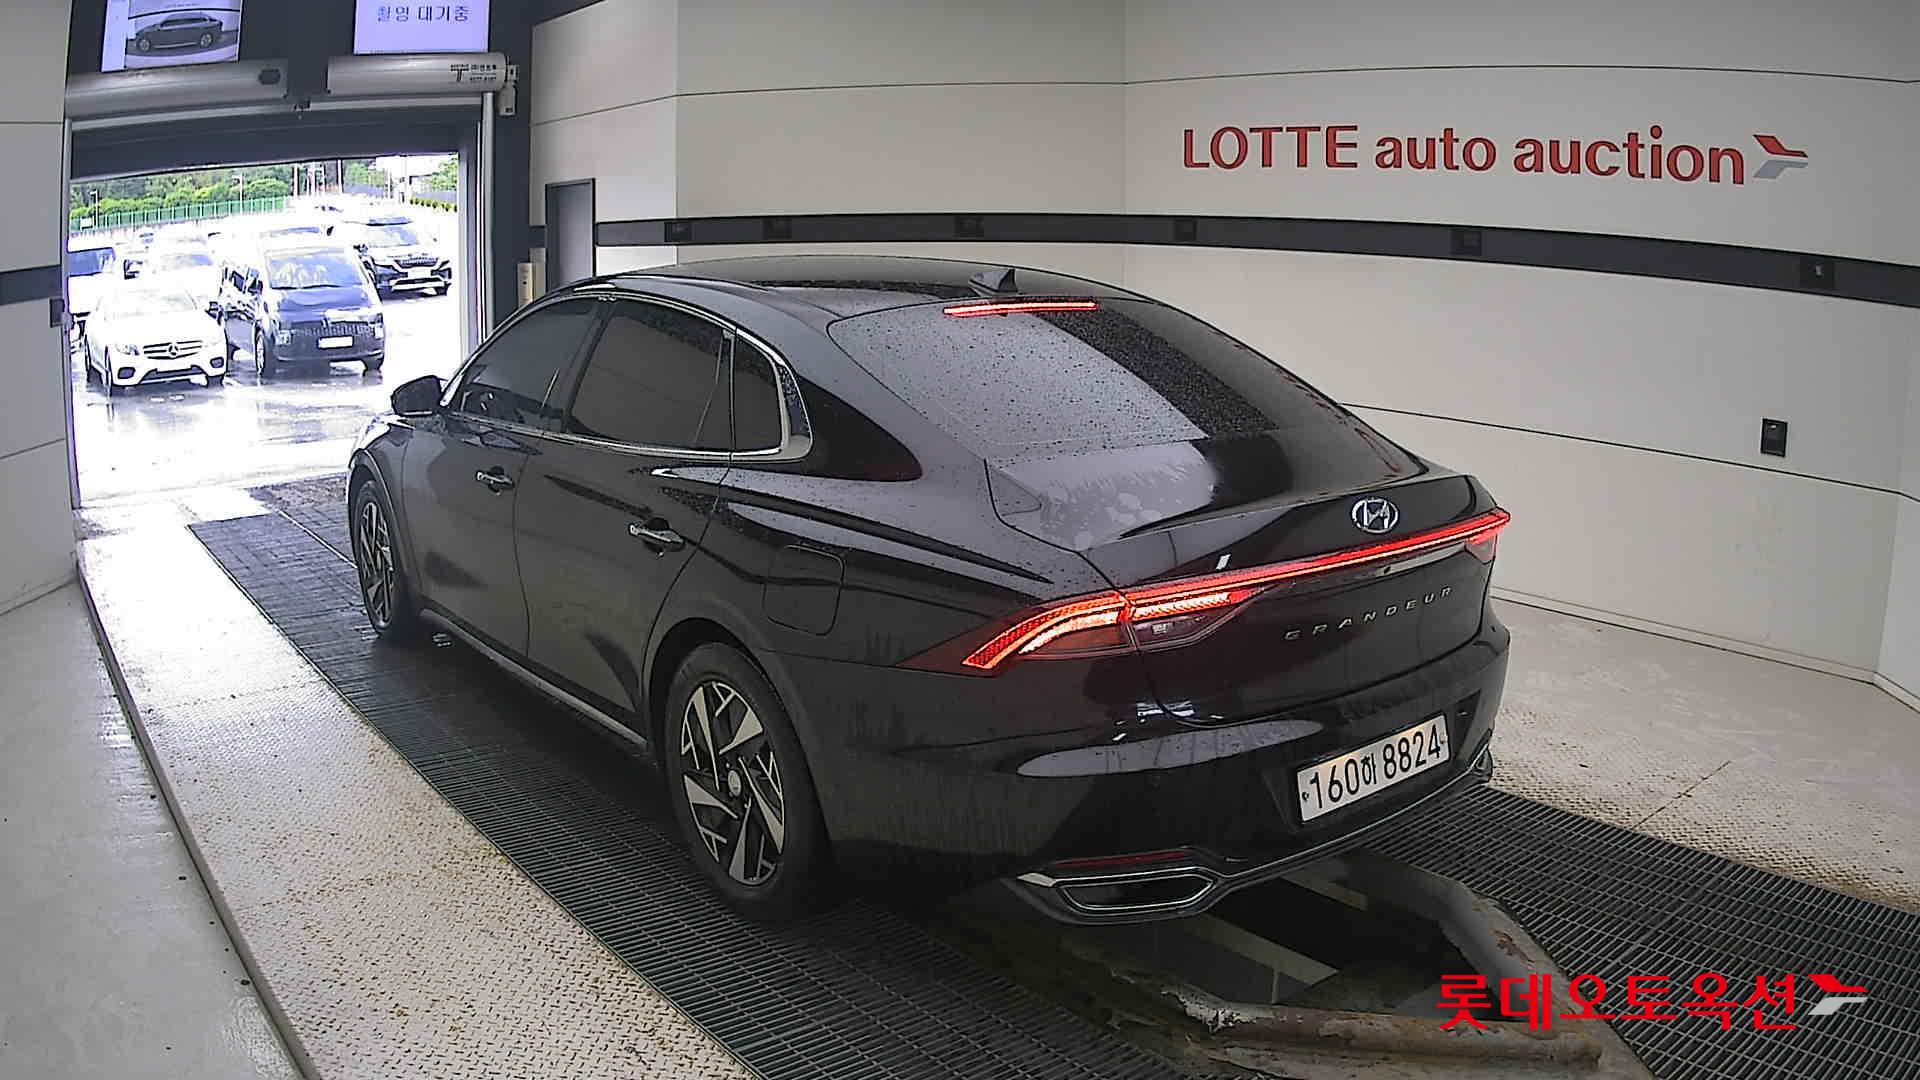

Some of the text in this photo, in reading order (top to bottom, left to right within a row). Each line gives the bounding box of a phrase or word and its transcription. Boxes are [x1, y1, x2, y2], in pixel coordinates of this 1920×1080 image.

[417, 5, 471, 22] 대기중
[1183, 125, 1746, 185] LOTTE auto auction
[1283, 585, 1452, 641] GRANDEUR
[1309, 723, 1442, 809] 160하 8824
